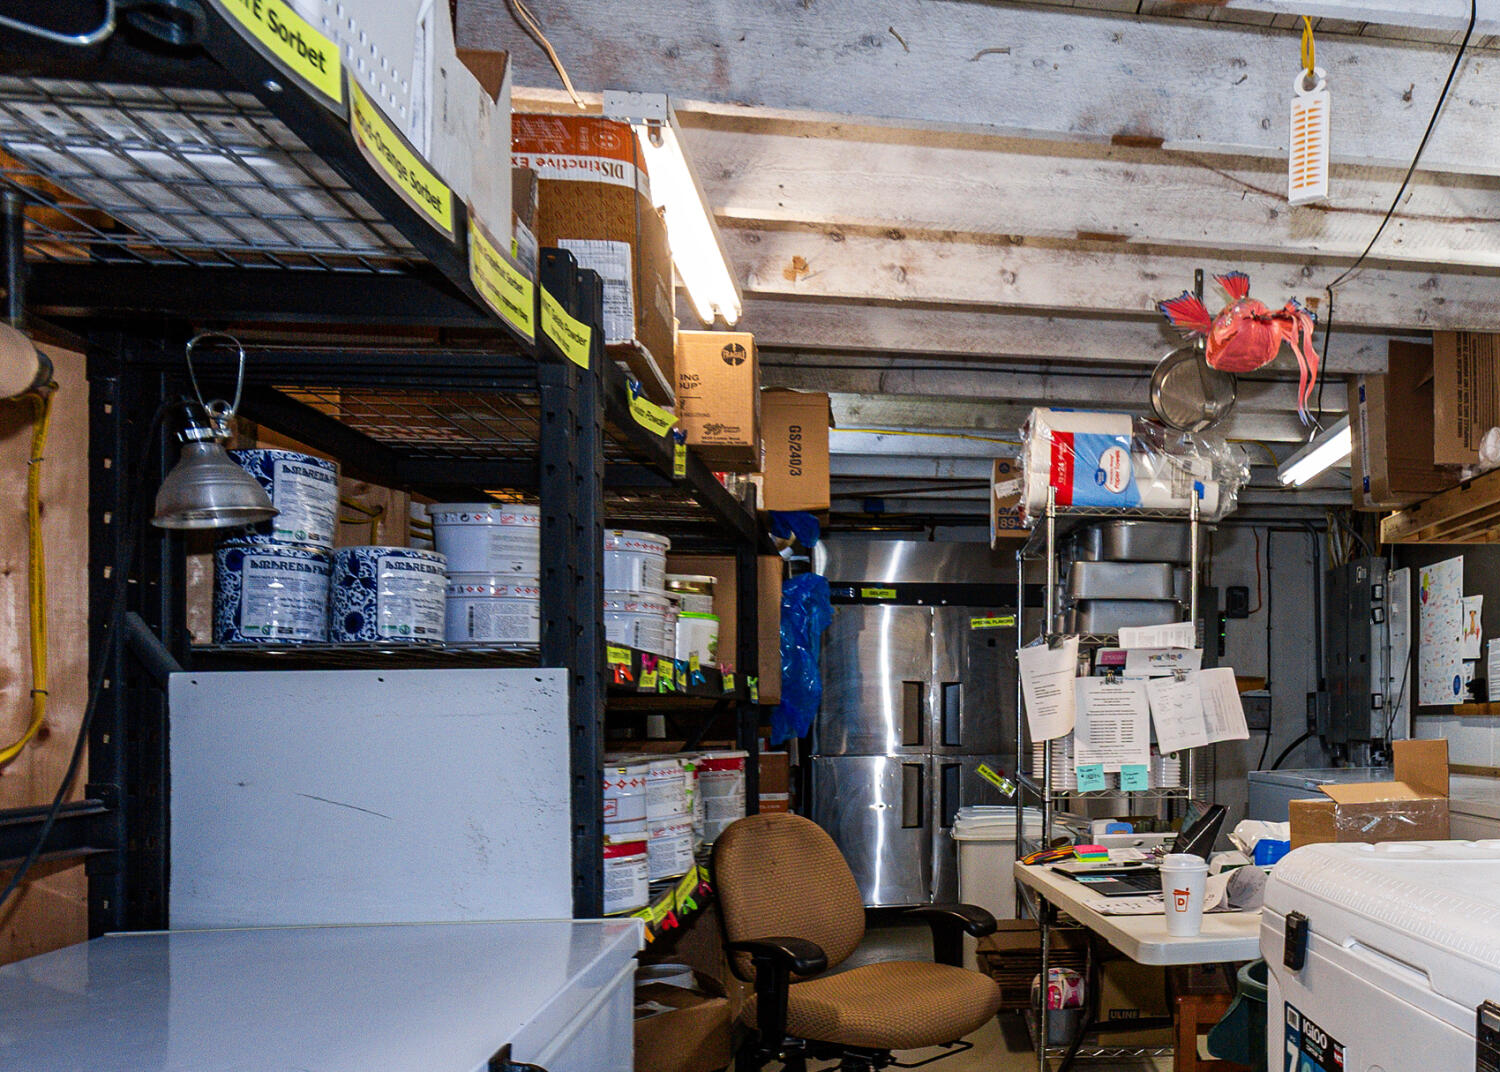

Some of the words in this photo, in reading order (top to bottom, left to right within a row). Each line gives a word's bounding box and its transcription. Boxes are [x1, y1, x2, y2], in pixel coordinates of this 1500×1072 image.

[267, 7, 327, 74] Sorbet
[409, 167, 443, 215] Sorbet
[536, 155, 625, 180] DIStinctive
[787, 425, 802, 477] GS/240/3
